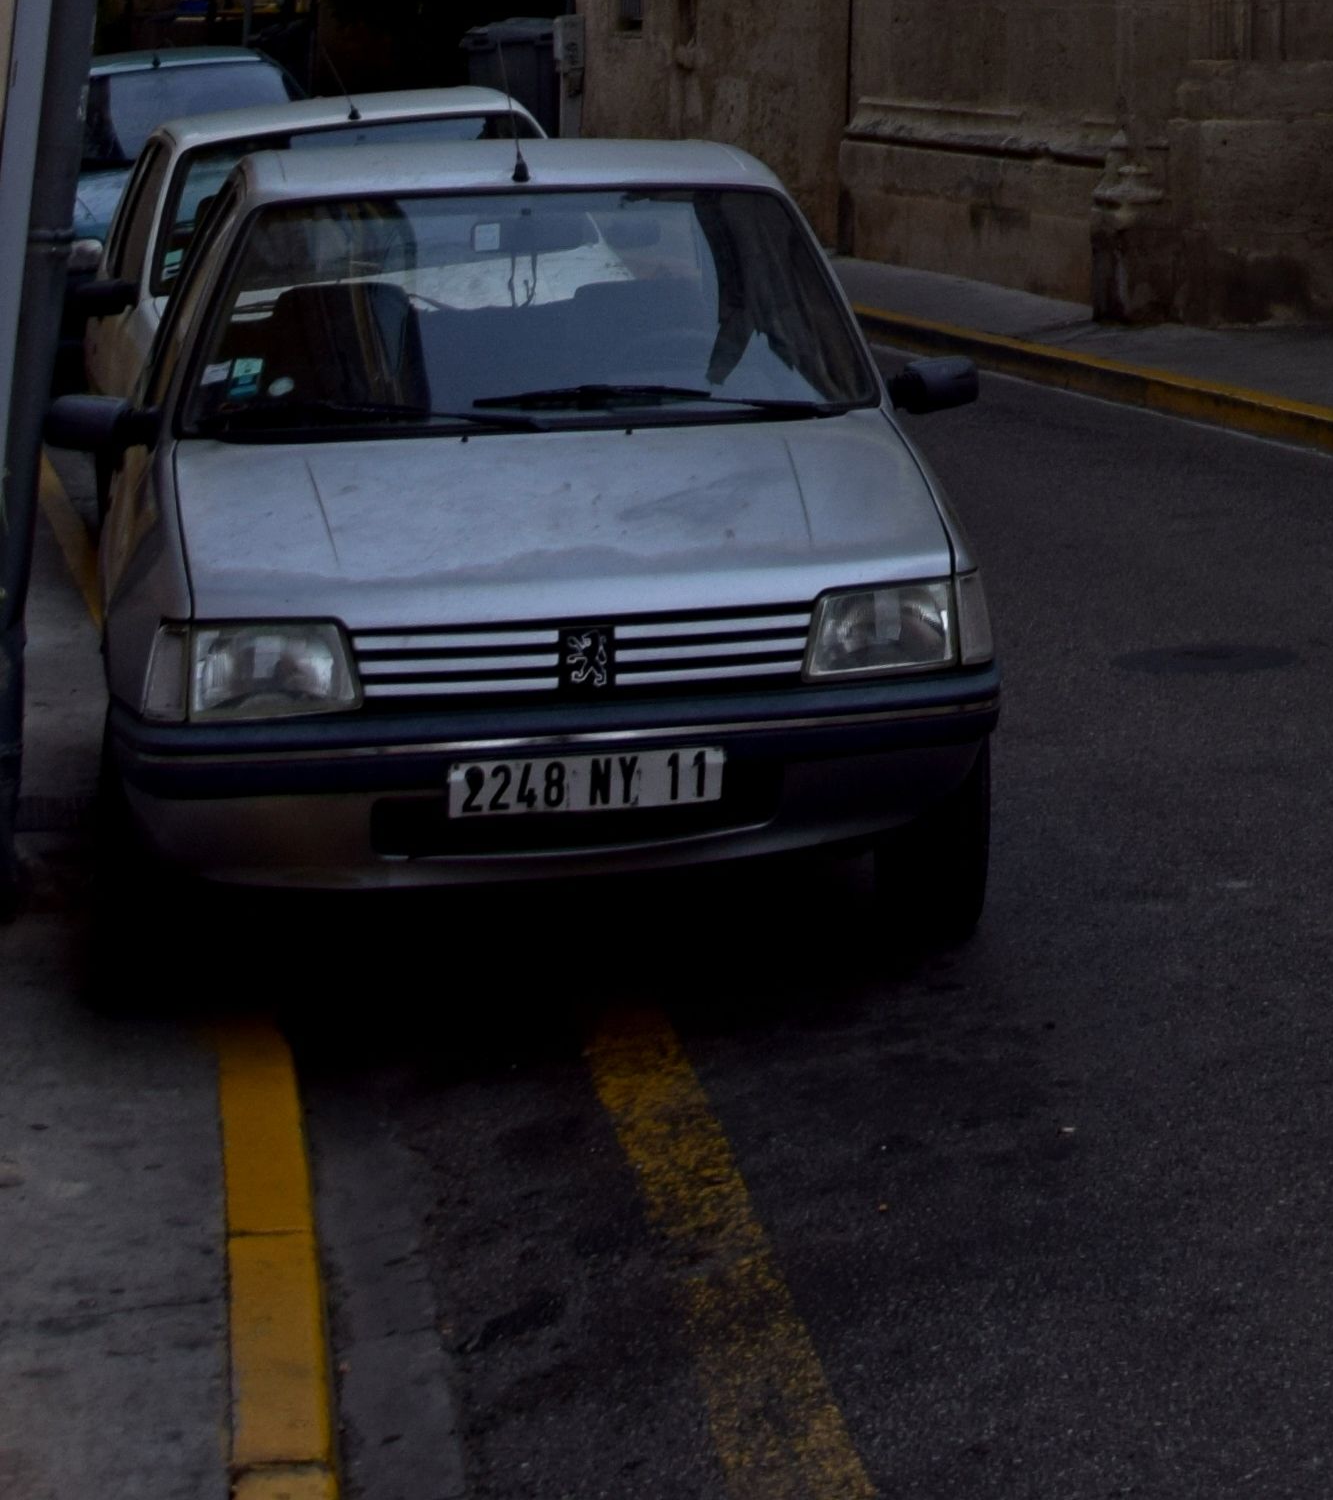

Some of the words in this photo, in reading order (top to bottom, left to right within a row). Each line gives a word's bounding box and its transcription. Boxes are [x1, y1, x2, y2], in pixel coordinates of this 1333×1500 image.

[462, 761, 565, 813] 2248
[590, 756, 638, 805] NY
[666, 751, 706, 800] 11
